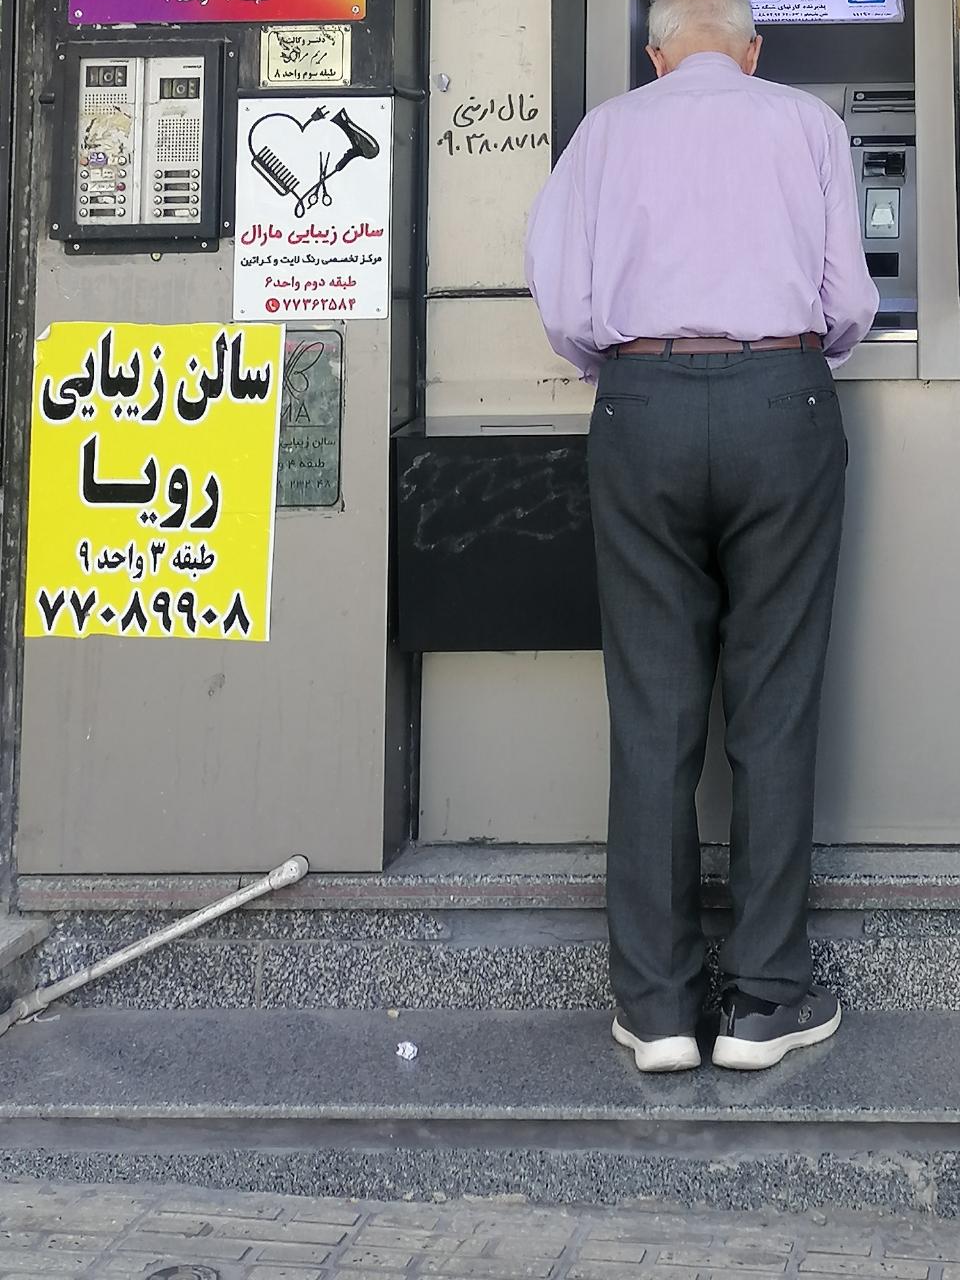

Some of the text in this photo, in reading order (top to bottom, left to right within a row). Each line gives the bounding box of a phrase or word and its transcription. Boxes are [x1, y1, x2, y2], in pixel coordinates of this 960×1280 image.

[307, 36, 326, 46] دفتر
[274, 68, 336, 80] طبقه سوم واحد ۸
[498, 93, 540, 121] فال
[240, 223, 384, 246] سالن زیبایی مارال
[240, 255, 272, 267] کراتین
[273, 258, 279, 266] و
[302, 254, 320, 266] رنگ
[360, 254, 382, 265] مرکز
[304, 278, 326, 291] دوم
[329, 275, 357, 290] طبقه
[282, 298, 357, 311] ۷۷۳۶۲۵۸۴
[42, 329, 271, 421] سالن زیبایی
[82, 435, 220, 529] رویا
[79, 541, 215, 580] طبقه ۳ واحد ۹
[38, 589, 251, 635] ۷۷۰۸۹۹۰۸
